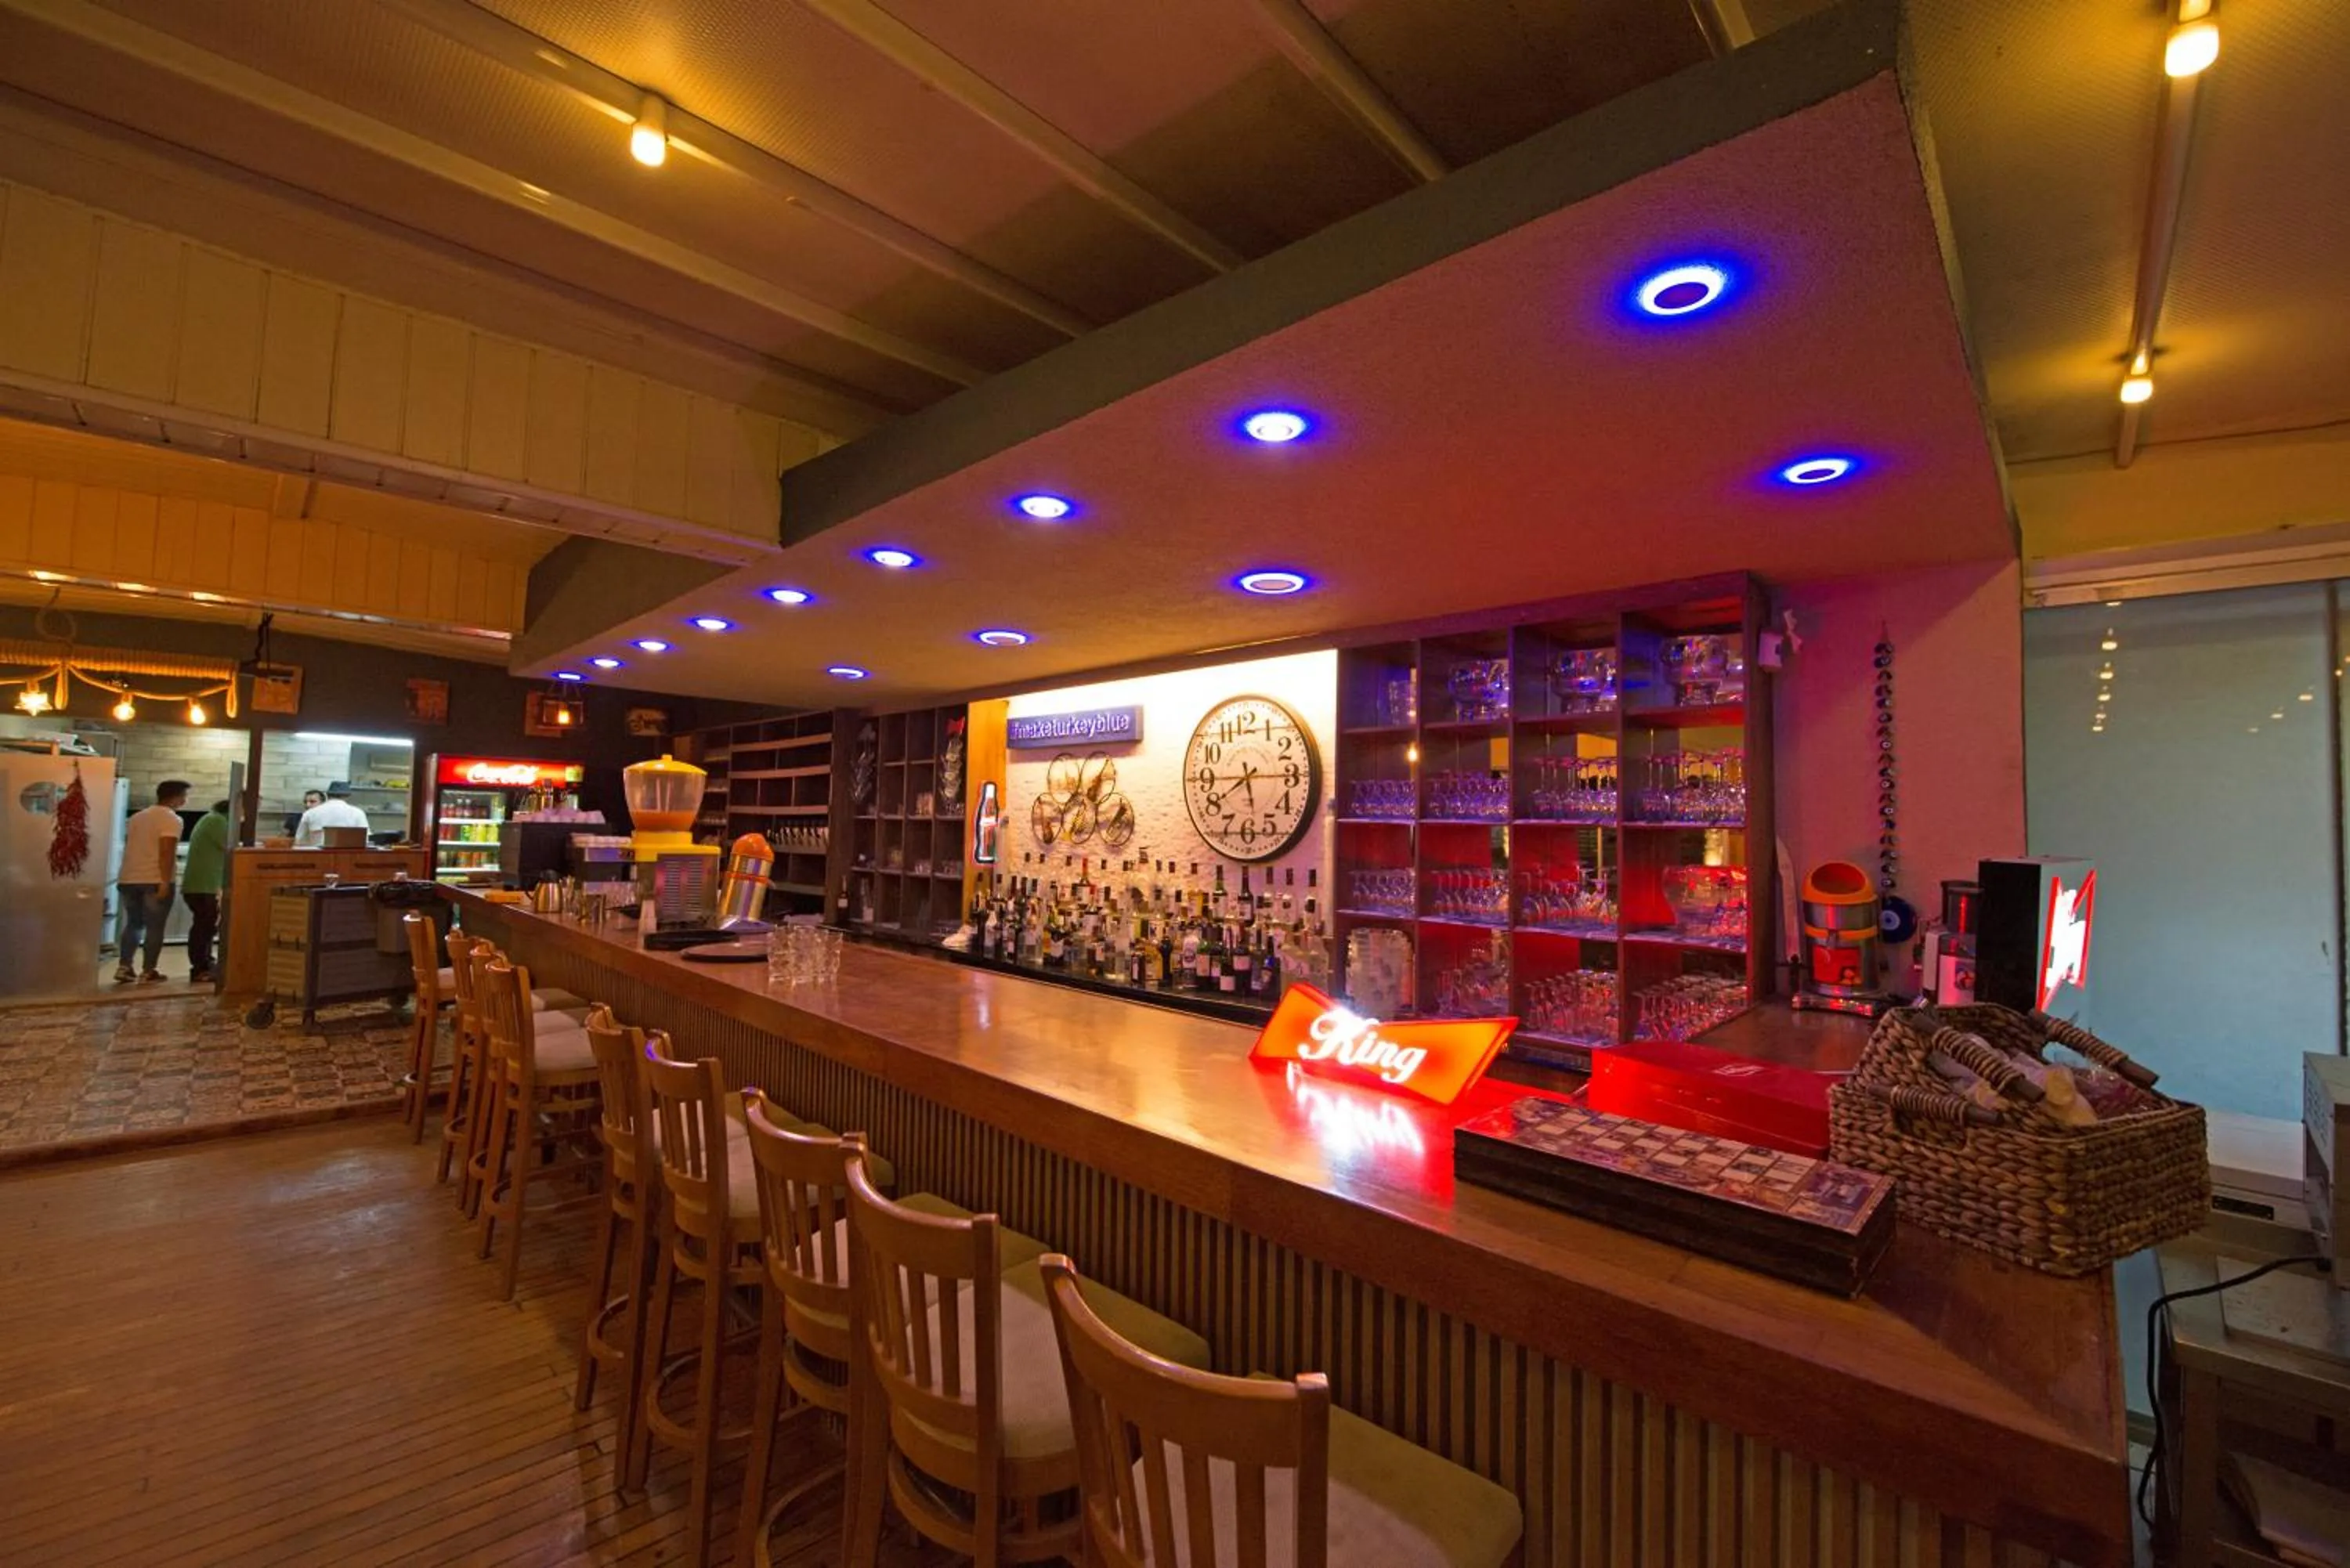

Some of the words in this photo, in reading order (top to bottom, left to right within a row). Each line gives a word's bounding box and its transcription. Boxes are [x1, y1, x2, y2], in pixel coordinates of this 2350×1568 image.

[1220, 721, 1234, 743] 11
[1237, 710, 1256, 735] 12
[1265, 719, 1271, 741] 1
[1205, 742, 1221, 764] 10
[1278, 736, 1292, 761] 2
[1199, 768, 1214, 793] 9
[1284, 763, 1300, 788] 3
[1206, 793, 1221, 816] 8
[1275, 789, 1291, 815] 4
[1221, 813, 1235, 836] 7
[1240, 818, 1256, 844] 6
[1262, 814, 1277, 837] 5
[1297, 1006, 1428, 1083] King
